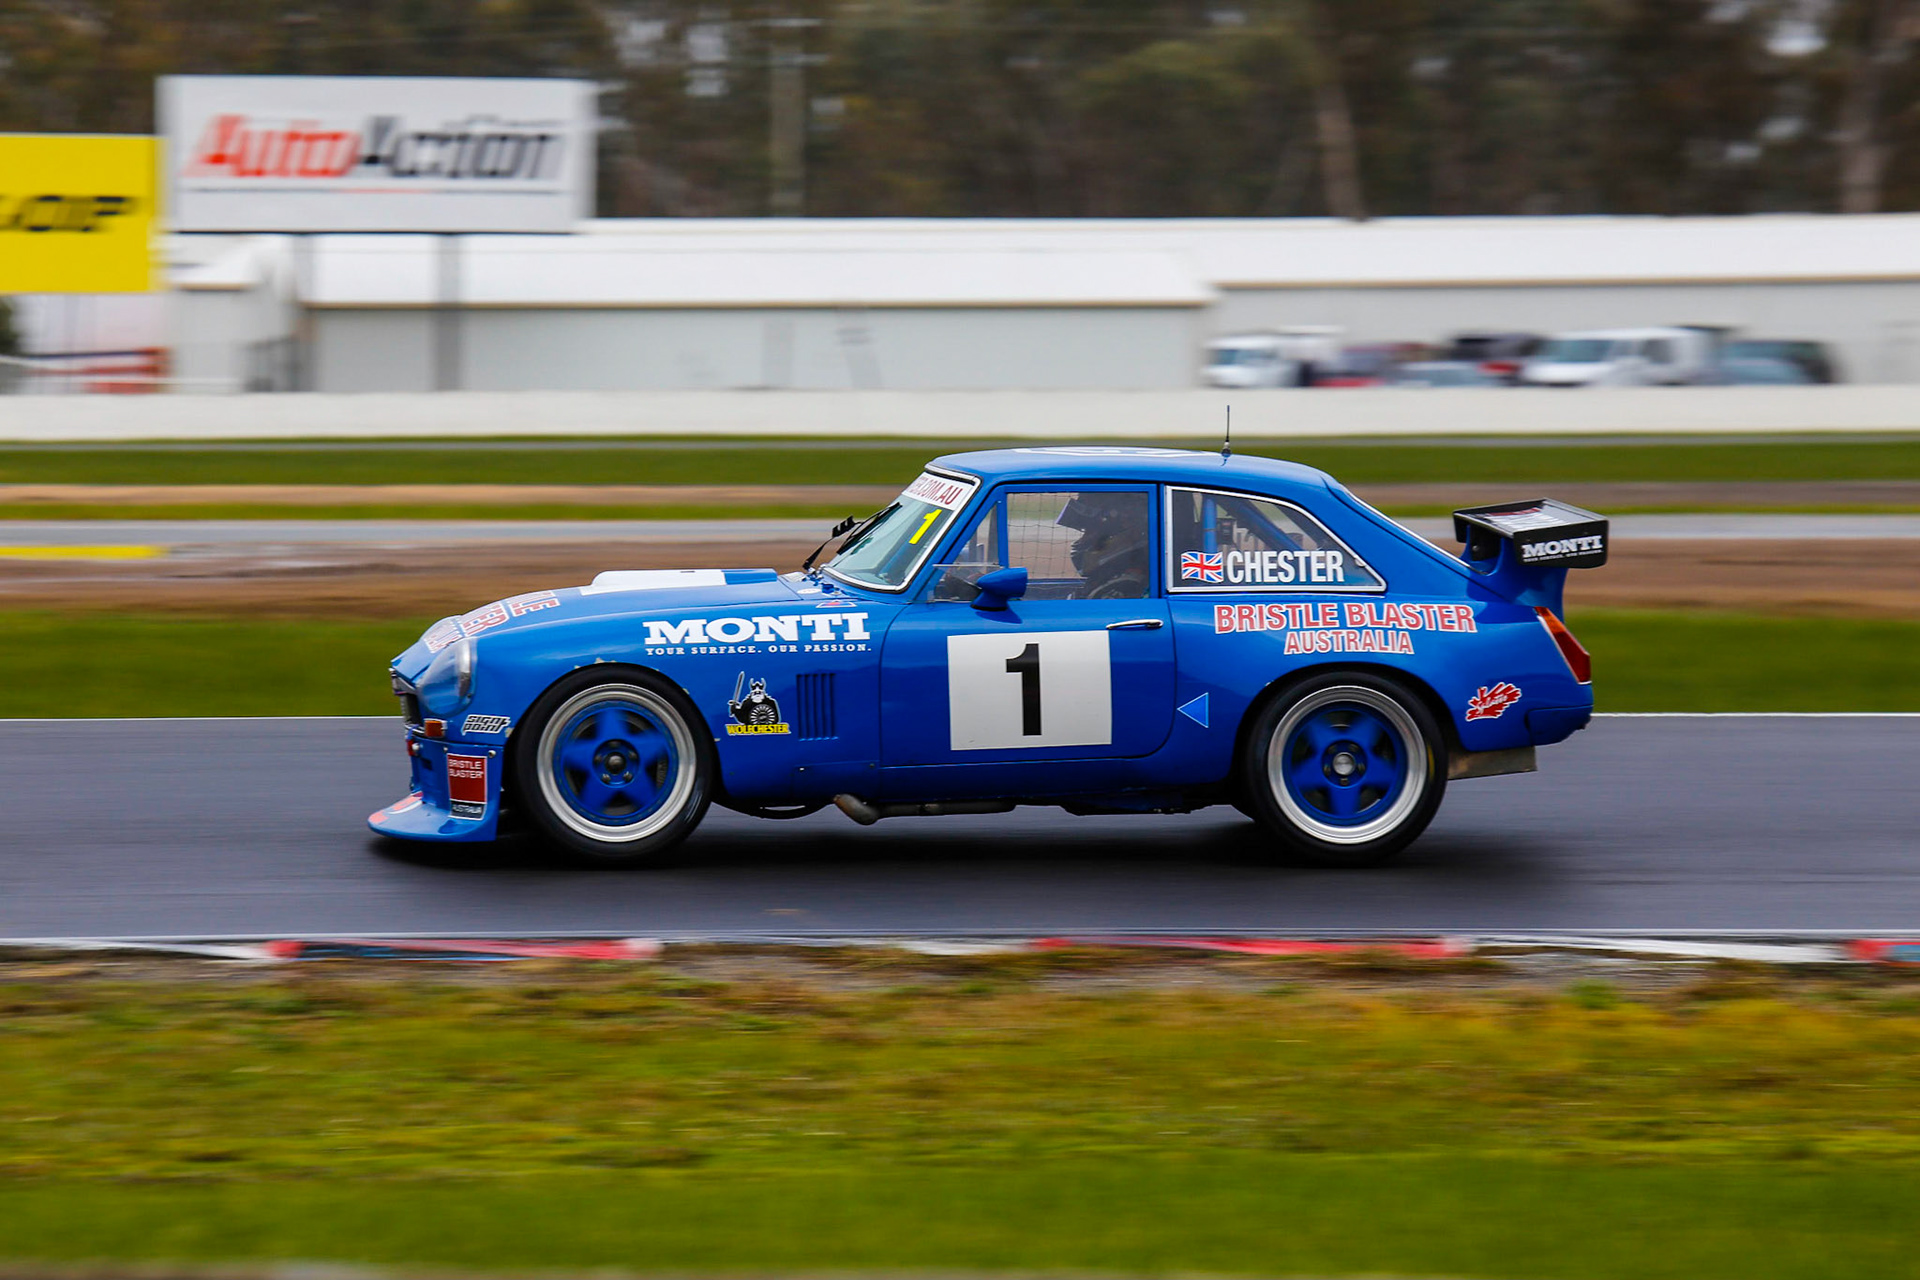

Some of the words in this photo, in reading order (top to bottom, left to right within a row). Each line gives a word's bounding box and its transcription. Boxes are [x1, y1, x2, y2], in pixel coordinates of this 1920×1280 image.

[908, 508, 943, 545] 1
[1521, 534, 1604, 559] MONTI
[1226, 550, 1345, 583] CHESTER
[642, 612, 871, 645] MONTI
[1214, 603, 1340, 634] BRISTLE
[1344, 602, 1478, 633] BLASTER
[645, 646, 685, 656] YOUR
[691, 645, 762, 655] SURFACE.
[768, 644, 798, 653] OUR
[804, 643, 872, 653] PASSION.
[1283, 629, 1415, 655] AUSTRALIA
[1005, 643, 1042, 737] 1
